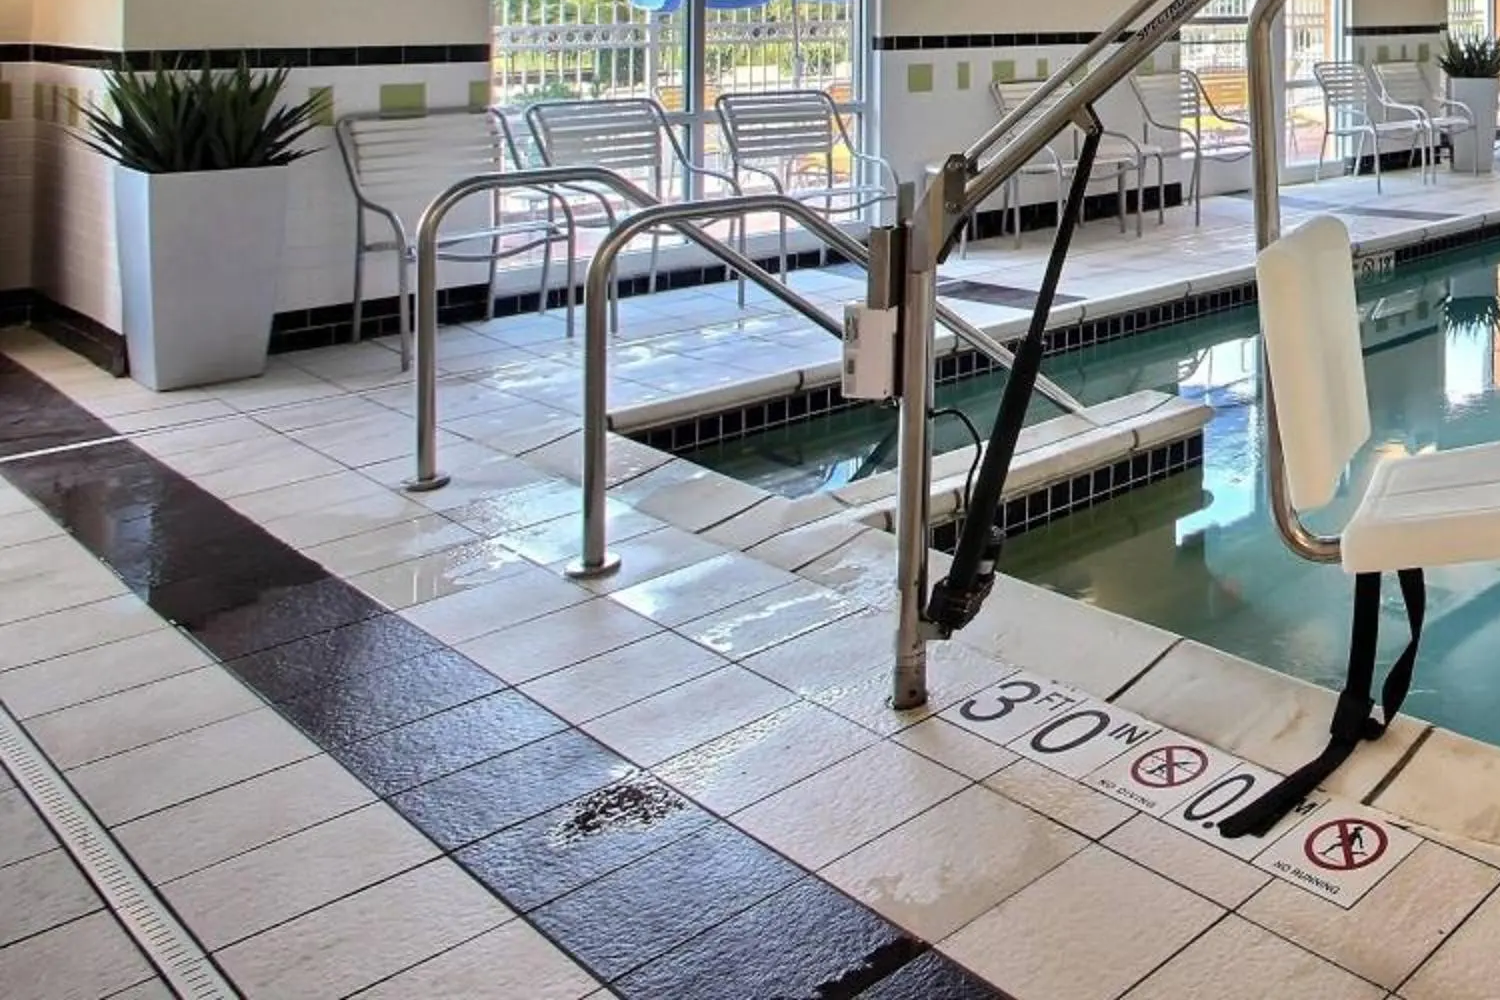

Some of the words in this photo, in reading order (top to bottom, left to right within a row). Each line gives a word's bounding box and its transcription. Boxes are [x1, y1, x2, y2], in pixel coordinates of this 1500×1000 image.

[959, 680, 1041, 722] 3
[1033, 691, 1076, 711] FT
[1029, 709, 1111, 753] 0
[1108, 722, 1149, 745] IN
[1099, 779, 1116, 789] NO
[1116, 787, 1157, 809] DIVING
[1273, 860, 1291, 872] NO
[1290, 868, 1341, 895] RUNNING
